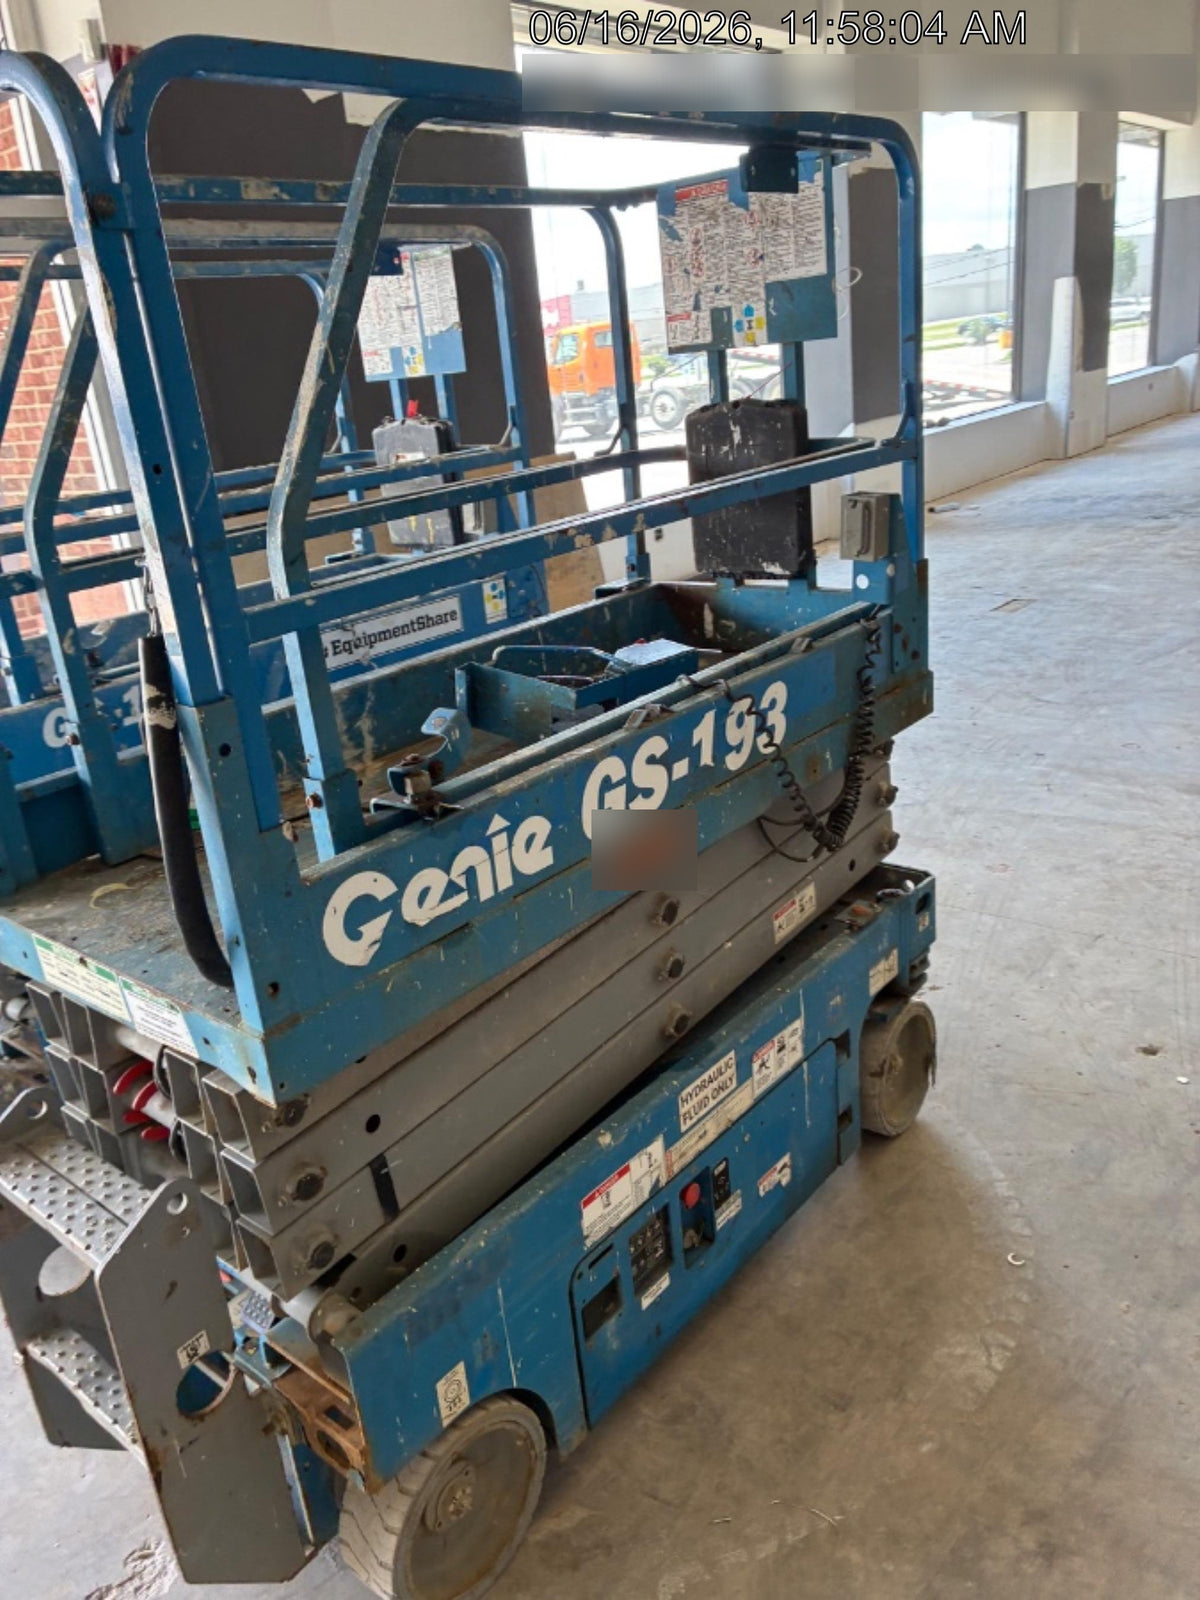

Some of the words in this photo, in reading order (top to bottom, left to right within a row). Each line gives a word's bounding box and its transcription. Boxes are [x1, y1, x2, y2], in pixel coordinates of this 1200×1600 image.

[331, 609, 458, 656] EquipmentShare
[322, 813, 554, 967] Genie
[680, 1057, 734, 1108] HYDRAULIC
[682, 1096, 710, 1126] FLUID
[711, 1073, 735, 1100] ONLY
